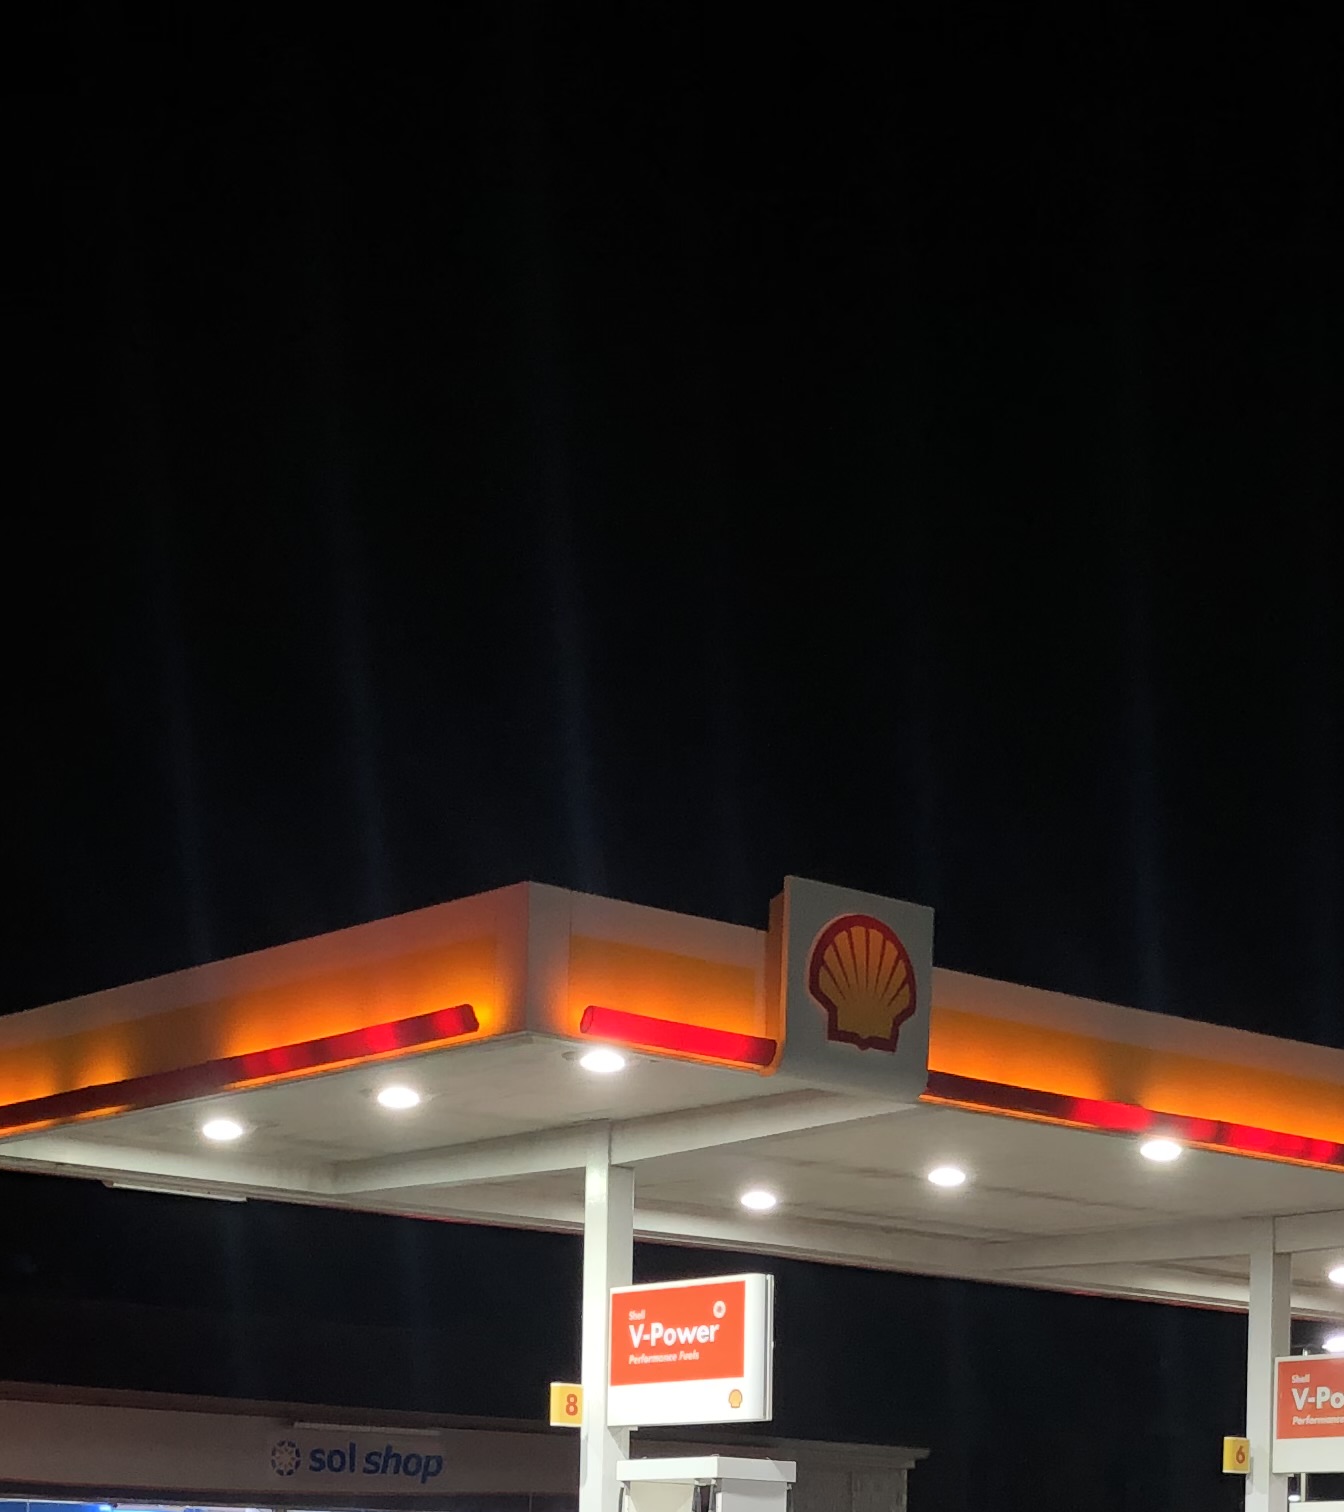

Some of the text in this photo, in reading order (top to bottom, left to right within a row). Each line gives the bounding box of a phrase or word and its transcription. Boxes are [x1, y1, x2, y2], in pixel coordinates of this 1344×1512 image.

[628, 1309, 646, 1321] Shell
[629, 1322, 720, 1348] V-Power
[628, 1349, 700, 1365] Performance Fuels
[565, 1393, 578, 1416] 8
[309, 1442, 443, 1484] sol shop
[1235, 1446, 1246, 1465] 6
